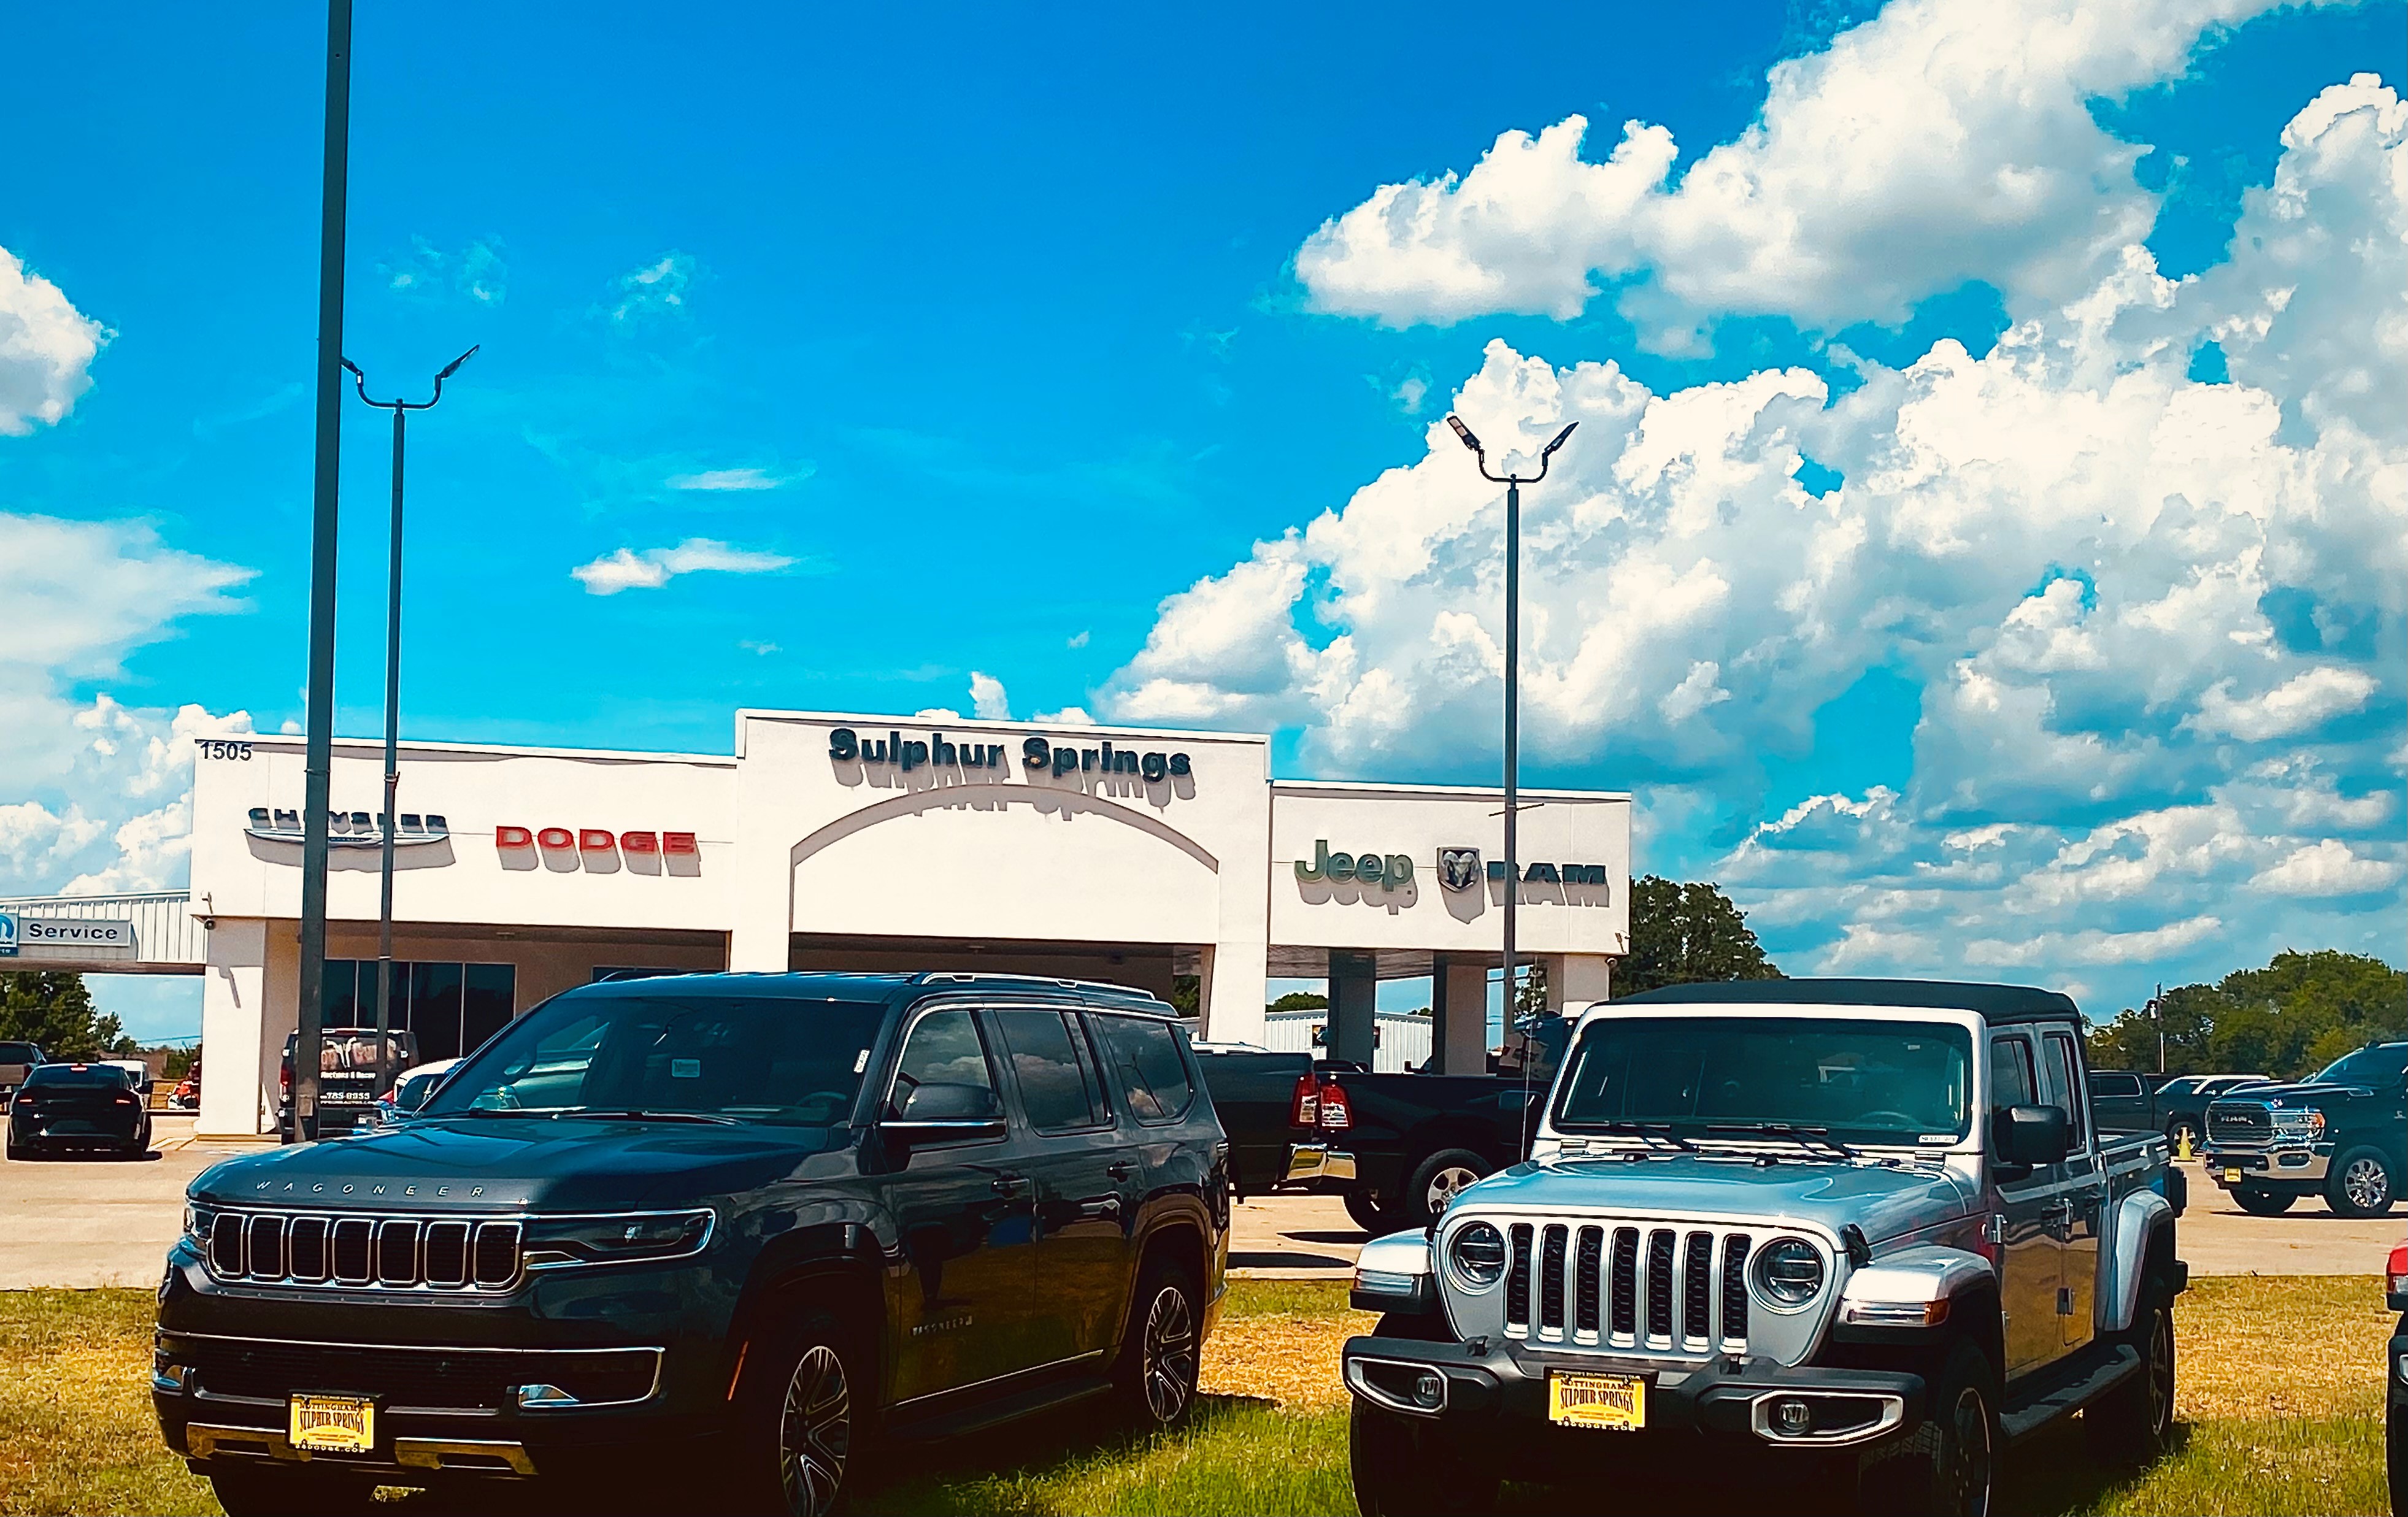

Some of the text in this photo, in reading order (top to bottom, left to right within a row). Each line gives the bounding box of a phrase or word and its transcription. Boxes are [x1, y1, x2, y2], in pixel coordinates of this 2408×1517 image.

[200, 741, 252, 761] 1505
[829, 728, 1190, 782] Sulphur Springs
[496, 826, 696, 853] DODGE
[1294, 839, 1414, 893] Jeep
[1487, 861, 1606, 884] RAM
[29, 923, 118, 940] Service
[256, 1181, 483, 1197] WAGONEER
[1560, 1387, 1634, 1415] SULPHUR SPRINGS
[299, 1410, 364, 1435] SULPHUR SPRINGS
